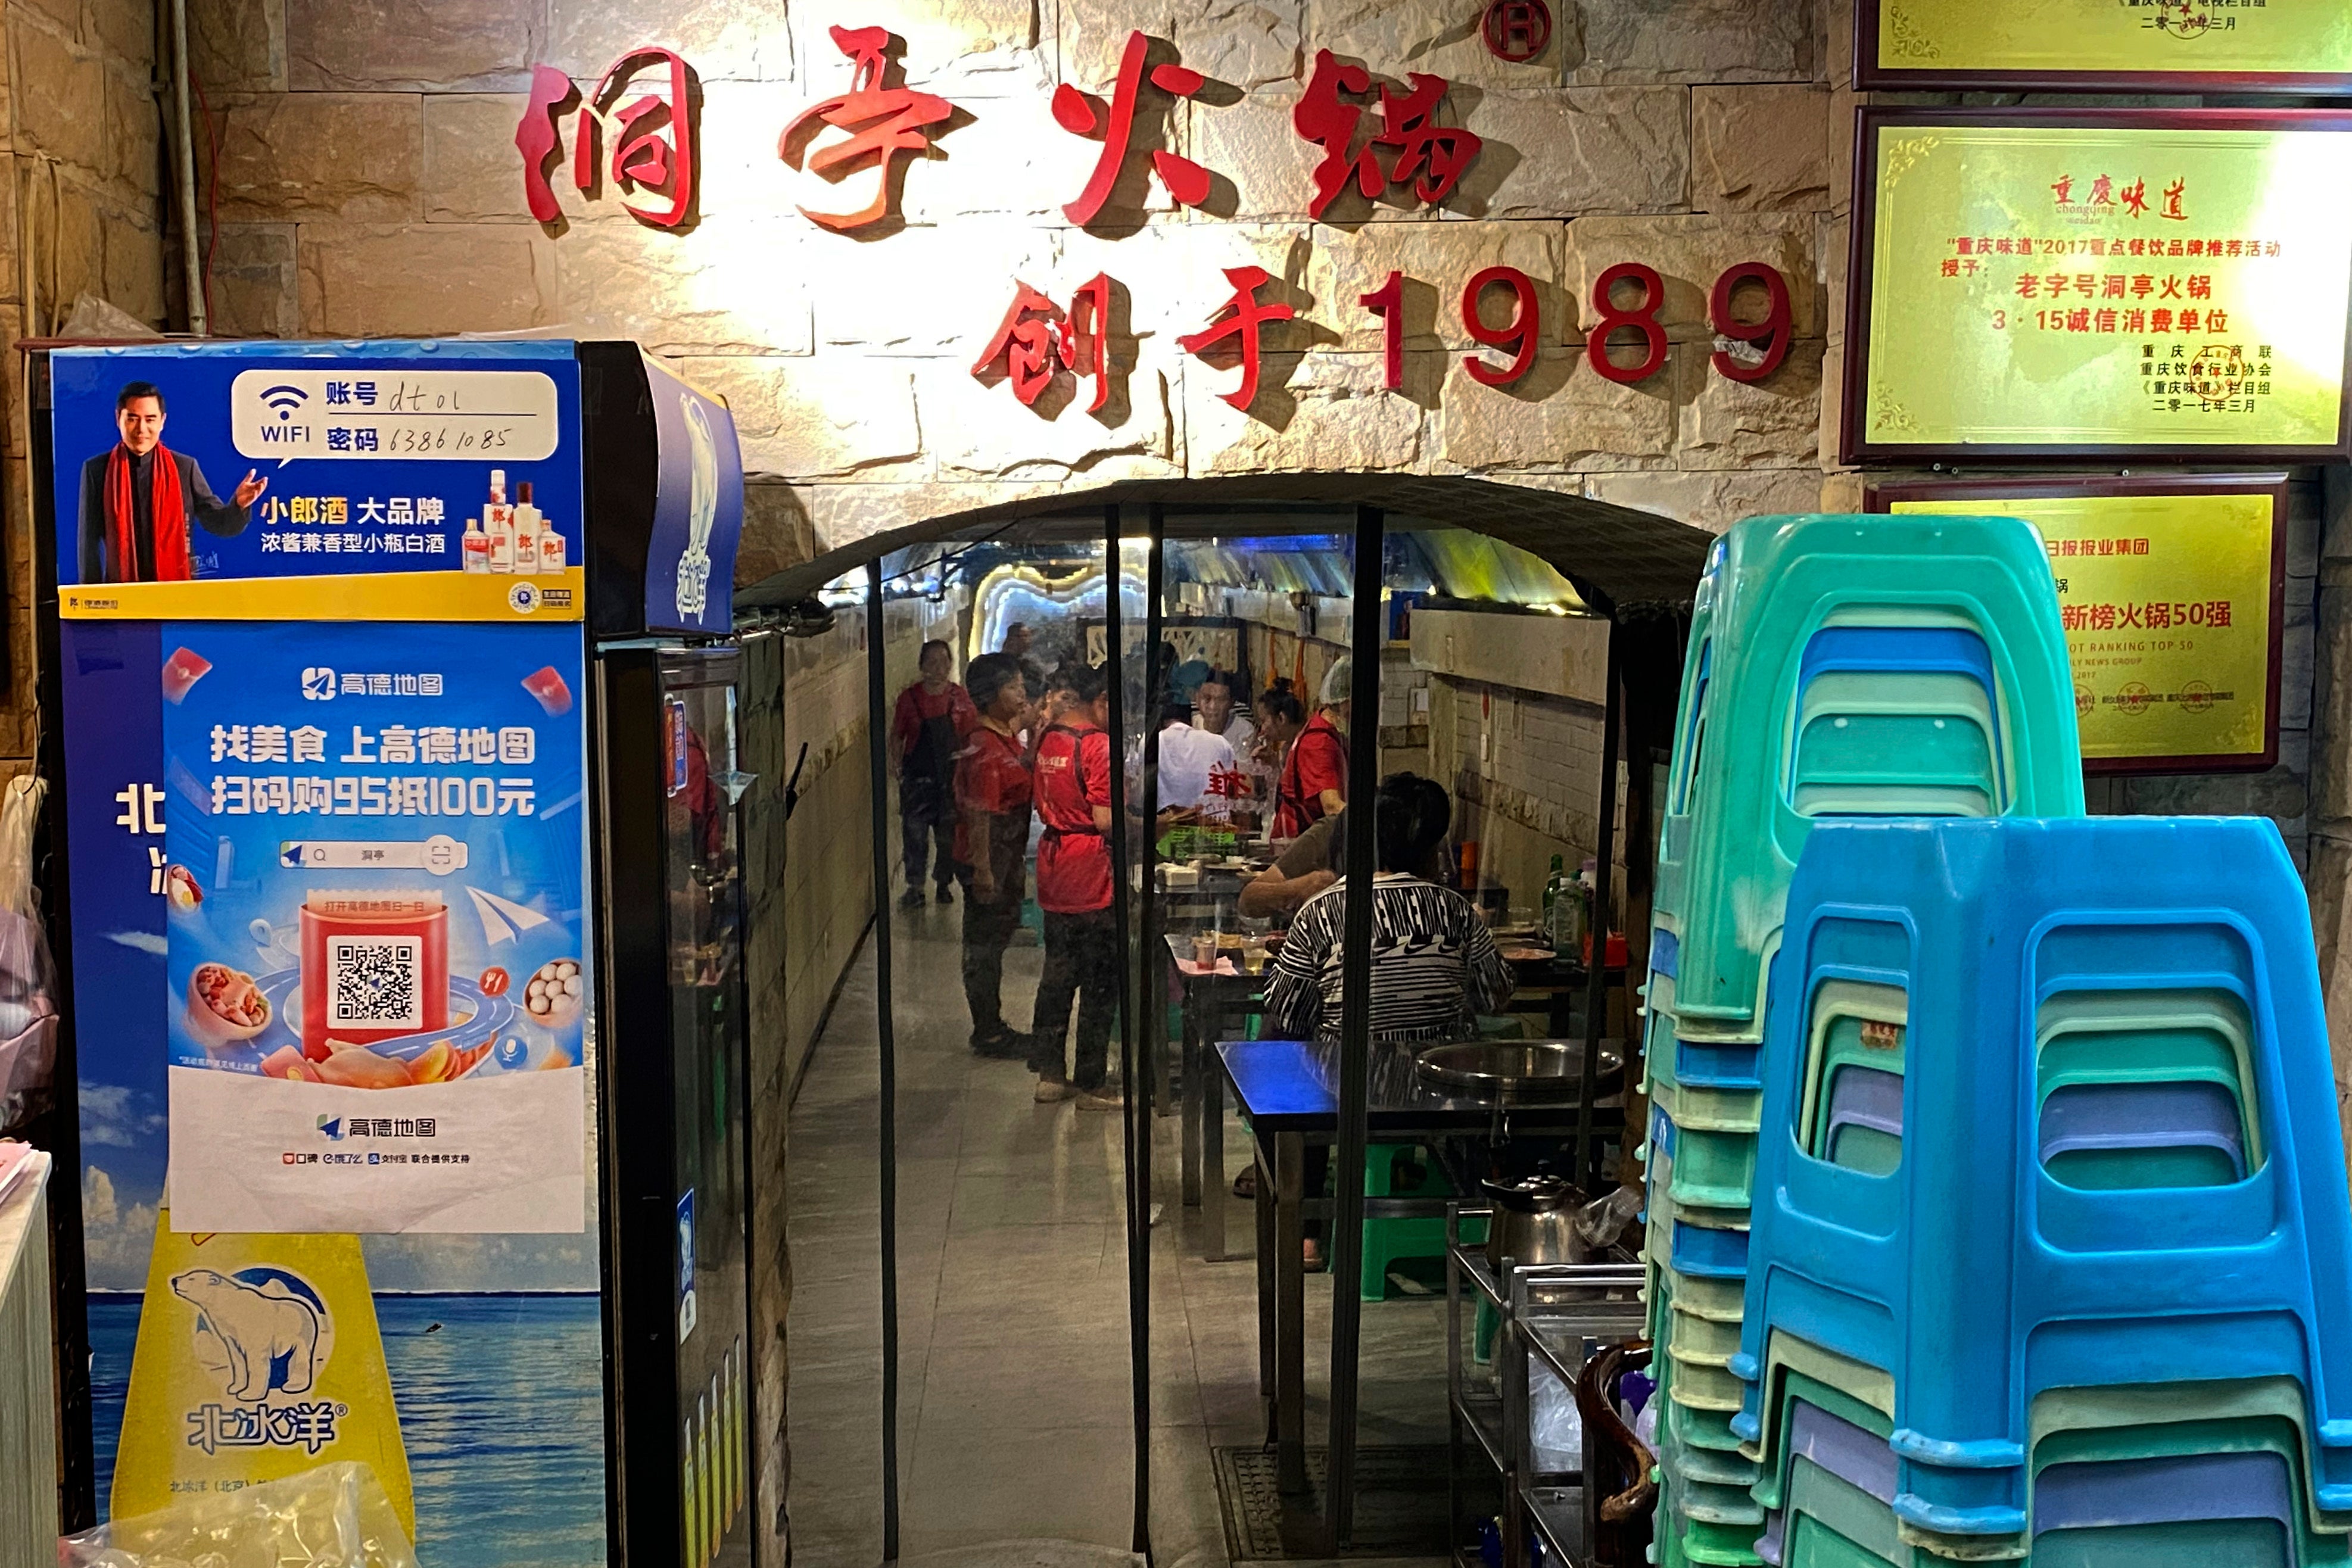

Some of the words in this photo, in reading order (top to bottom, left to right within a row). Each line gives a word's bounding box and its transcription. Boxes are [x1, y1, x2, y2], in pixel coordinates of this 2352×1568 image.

[2015, 272, 2211, 300] 老字号洞亭火锅
[326, 381, 378, 406] 账号
[2152, 398, 2256, 413] 二零一七年三月
[260, 426, 310, 442] WIFI
[326, 427, 379, 451] 密码
[260, 496, 348, 525] 小郎酒
[357, 497, 446, 525] 大品牌
[260, 532, 446, 553] 浓酱兼香型小瓶白酒
[2061, 600, 2232, 631] 新榜火锅50强
[2069, 643, 2084, 653] OT
[2090, 641, 2145, 652] RANKING
[2151, 641, 2174, 651] TOP
[2180, 641, 2194, 650] 50
[341, 674, 443, 696] 高德地图
[210, 724, 328, 763] 找美食
[339, 724, 535, 764] 上高德地图
[211, 775, 536, 816] 扫码购95抵100元
[361, 849, 385, 861] 洞亭
[325, 900, 425, 912] 打开高德地图扫一扫
[349, 1118, 436, 1137] 高德地图
[381, 1154, 407, 1164] 支付宝
[411, 1154, 470, 1164] 联合提供支持
[187, 1402, 335, 1455] 北冰洋
